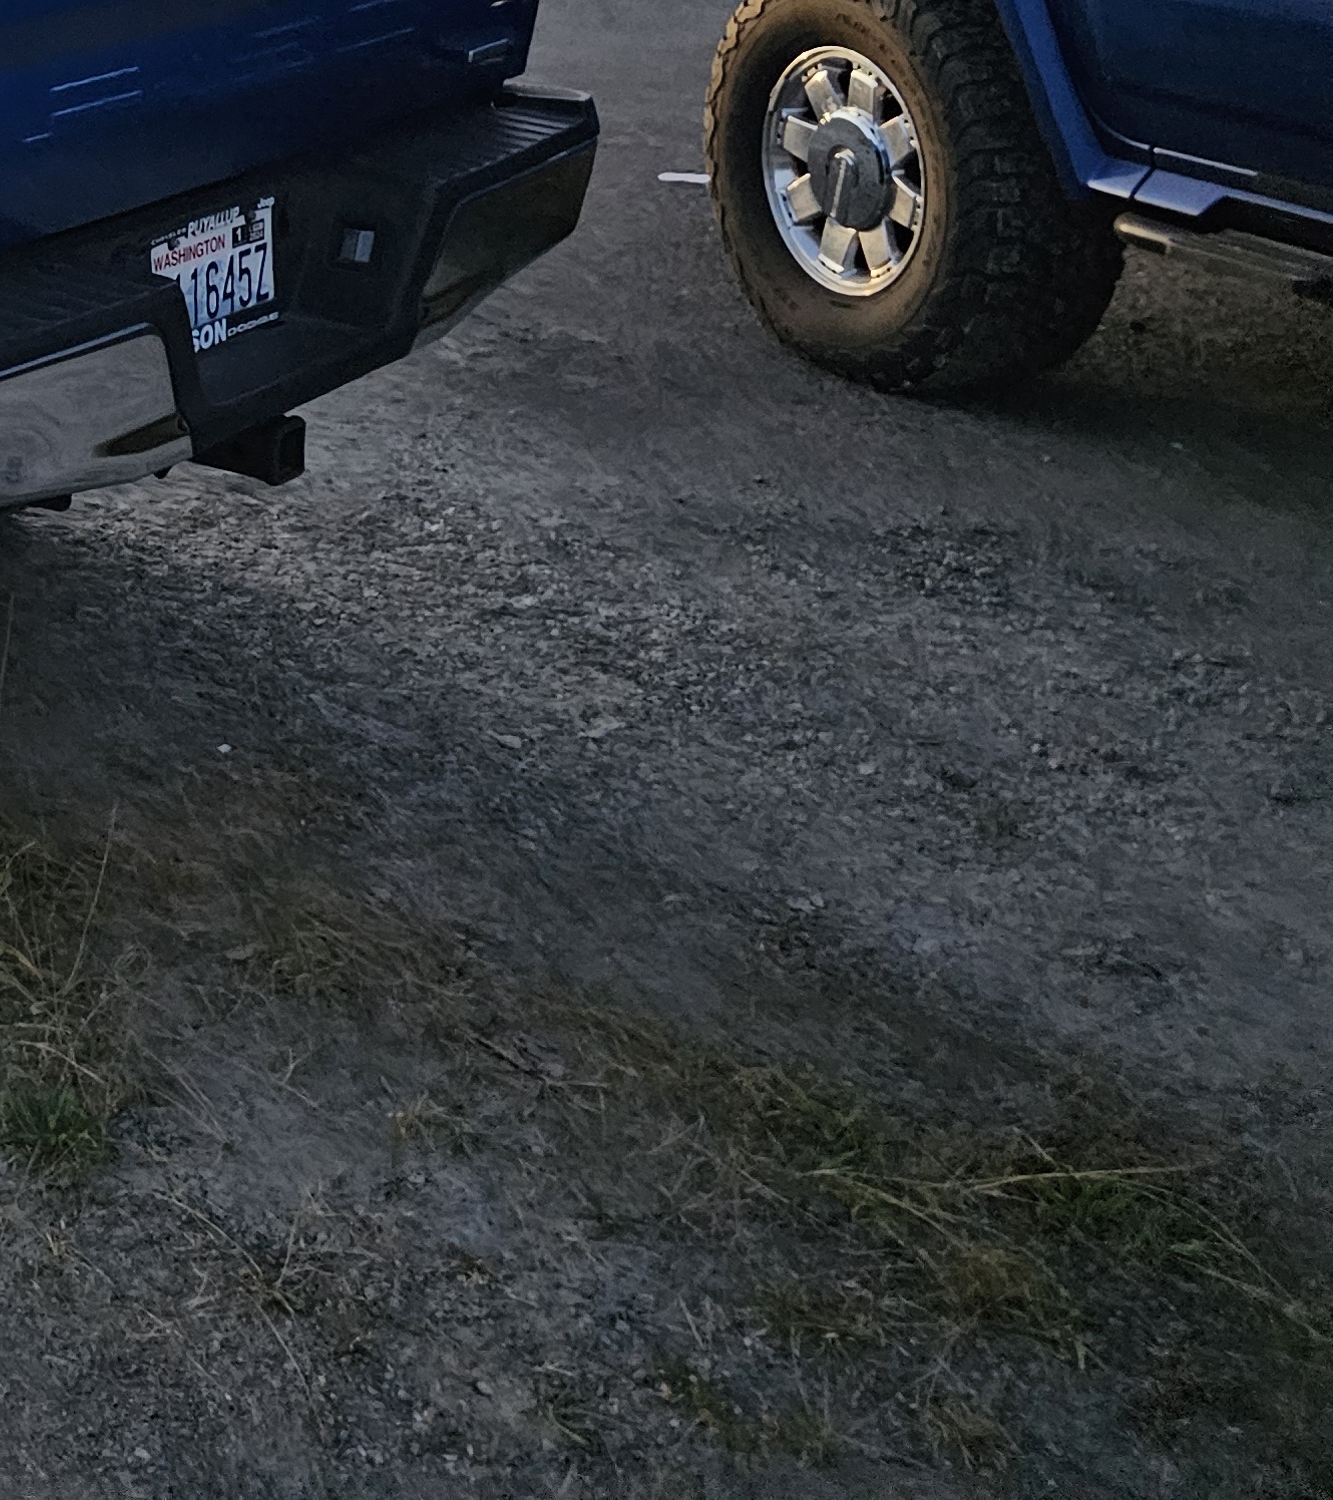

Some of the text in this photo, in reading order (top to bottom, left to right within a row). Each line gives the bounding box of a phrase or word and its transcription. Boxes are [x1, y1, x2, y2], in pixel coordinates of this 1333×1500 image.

[188, 207, 239, 236] PUYALLUP
[153, 233, 226, 272] WASHINGTON
[190, 244, 269, 324] 1645Z
